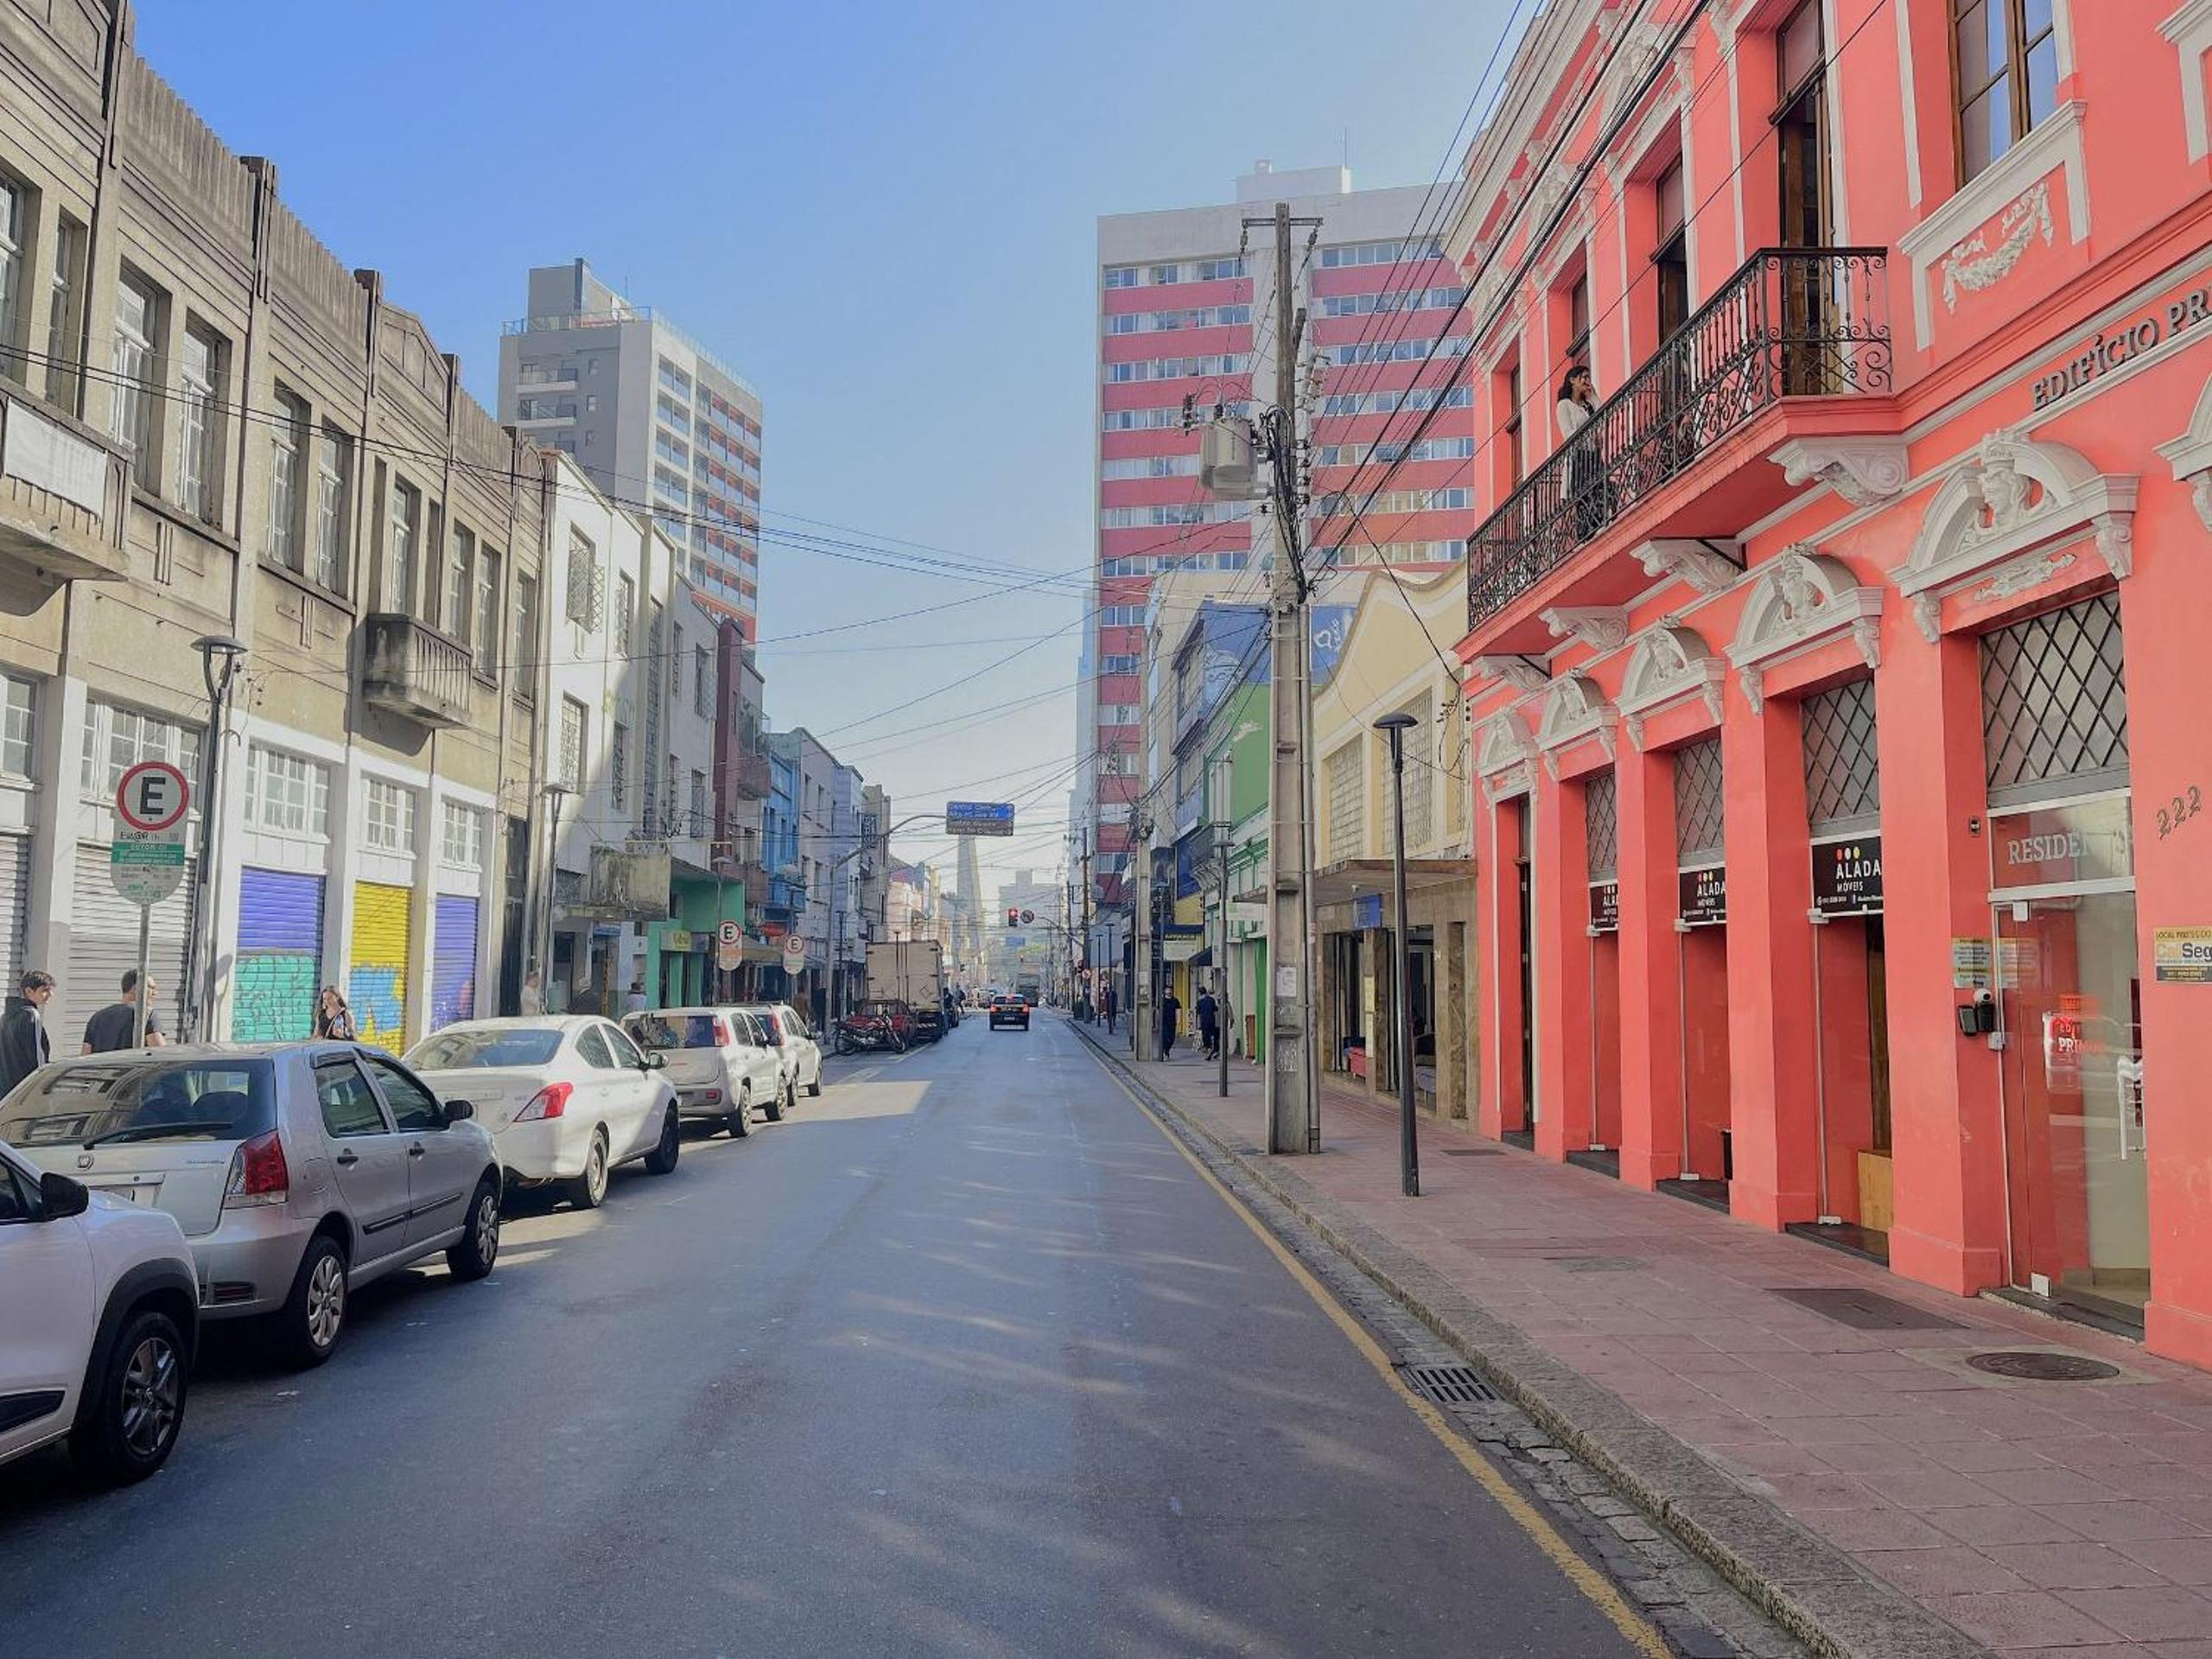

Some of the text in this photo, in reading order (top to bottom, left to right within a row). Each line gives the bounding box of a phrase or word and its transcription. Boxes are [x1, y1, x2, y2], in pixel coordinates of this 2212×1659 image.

[2031, 283, 2212, 411] EDIFÍCIO PR
[140, 777, 166, 815] E
[2157, 785, 2202, 840] 222
[1836, 859, 1882, 880] ALADA
[1697, 881, 1726, 897] ALADA
[1837, 880, 1864, 893] MÓVEIS
[724, 925, 734, 940] E
[791, 938, 799, 950] E
